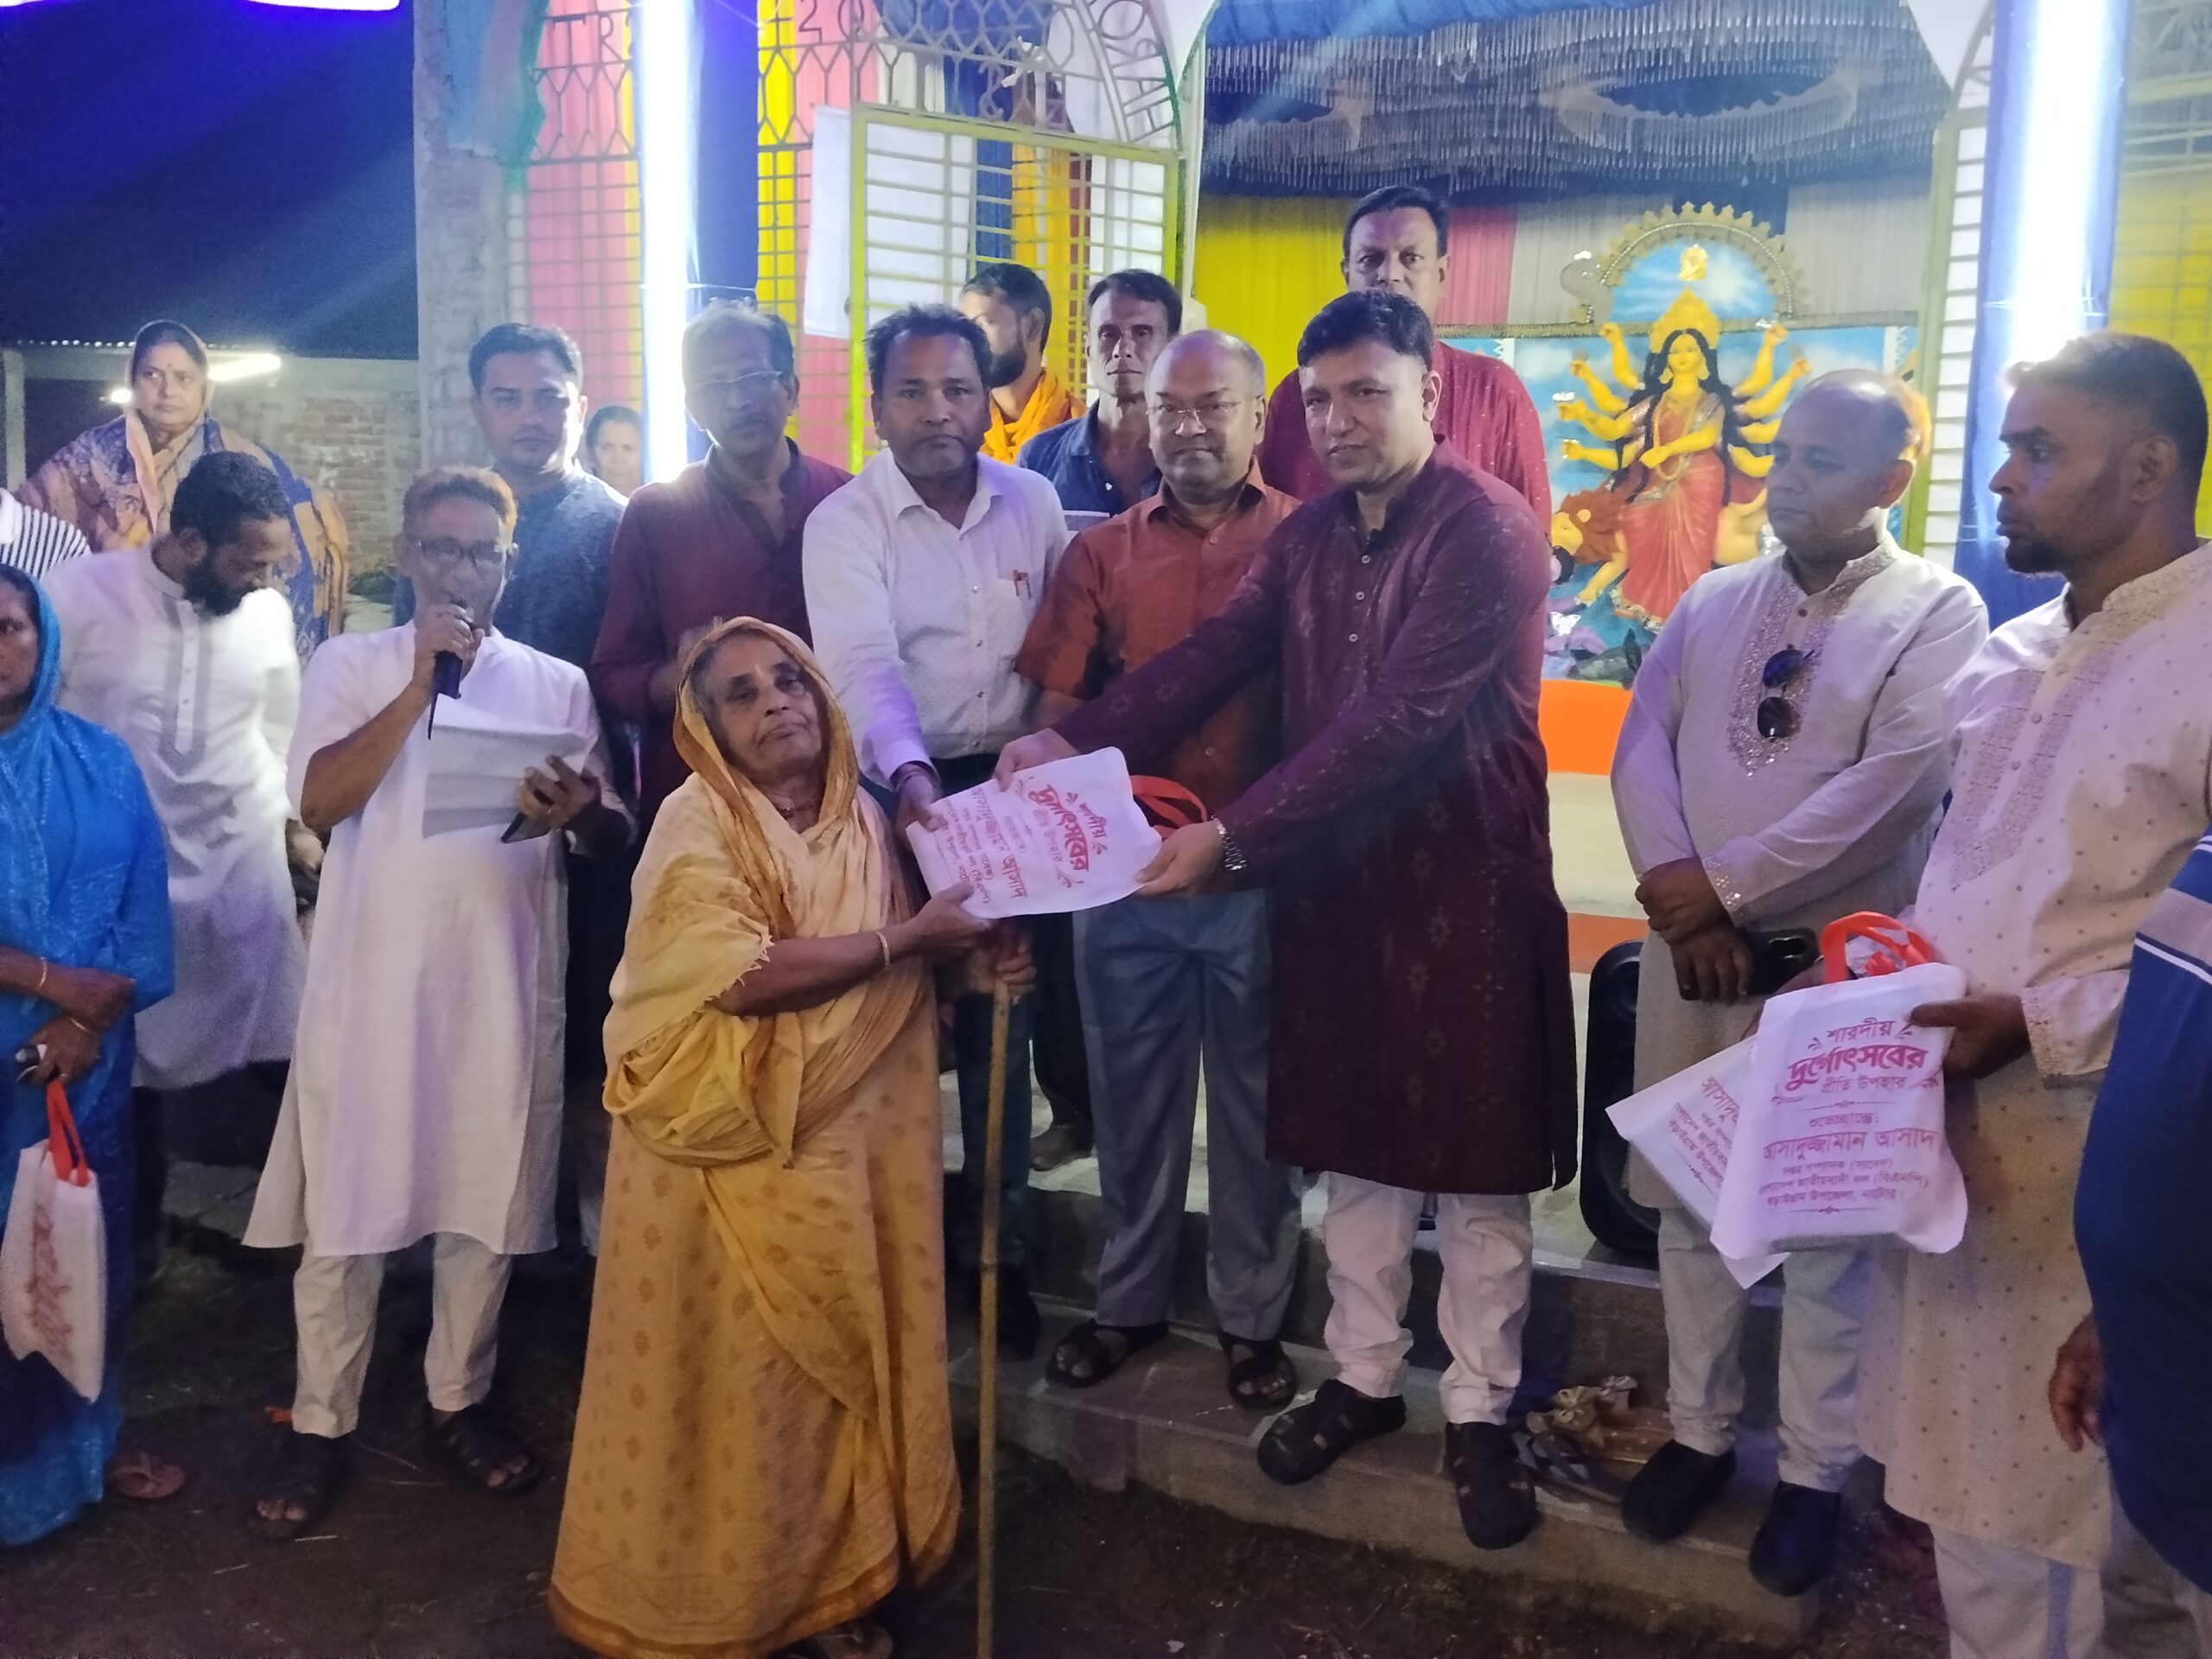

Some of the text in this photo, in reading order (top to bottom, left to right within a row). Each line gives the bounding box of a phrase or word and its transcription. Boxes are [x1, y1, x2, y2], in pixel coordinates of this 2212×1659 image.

[1004, 854, 1027, 897] আসাদ
[1827, 1016, 1895, 1042] শারদীয়
[1785, 1044, 1929, 1090] দুর্গোৎসবের
[1821, 1075, 1906, 1094] প্রীতি উপহার
[1875, 1127, 1937, 1152] আসাদ
